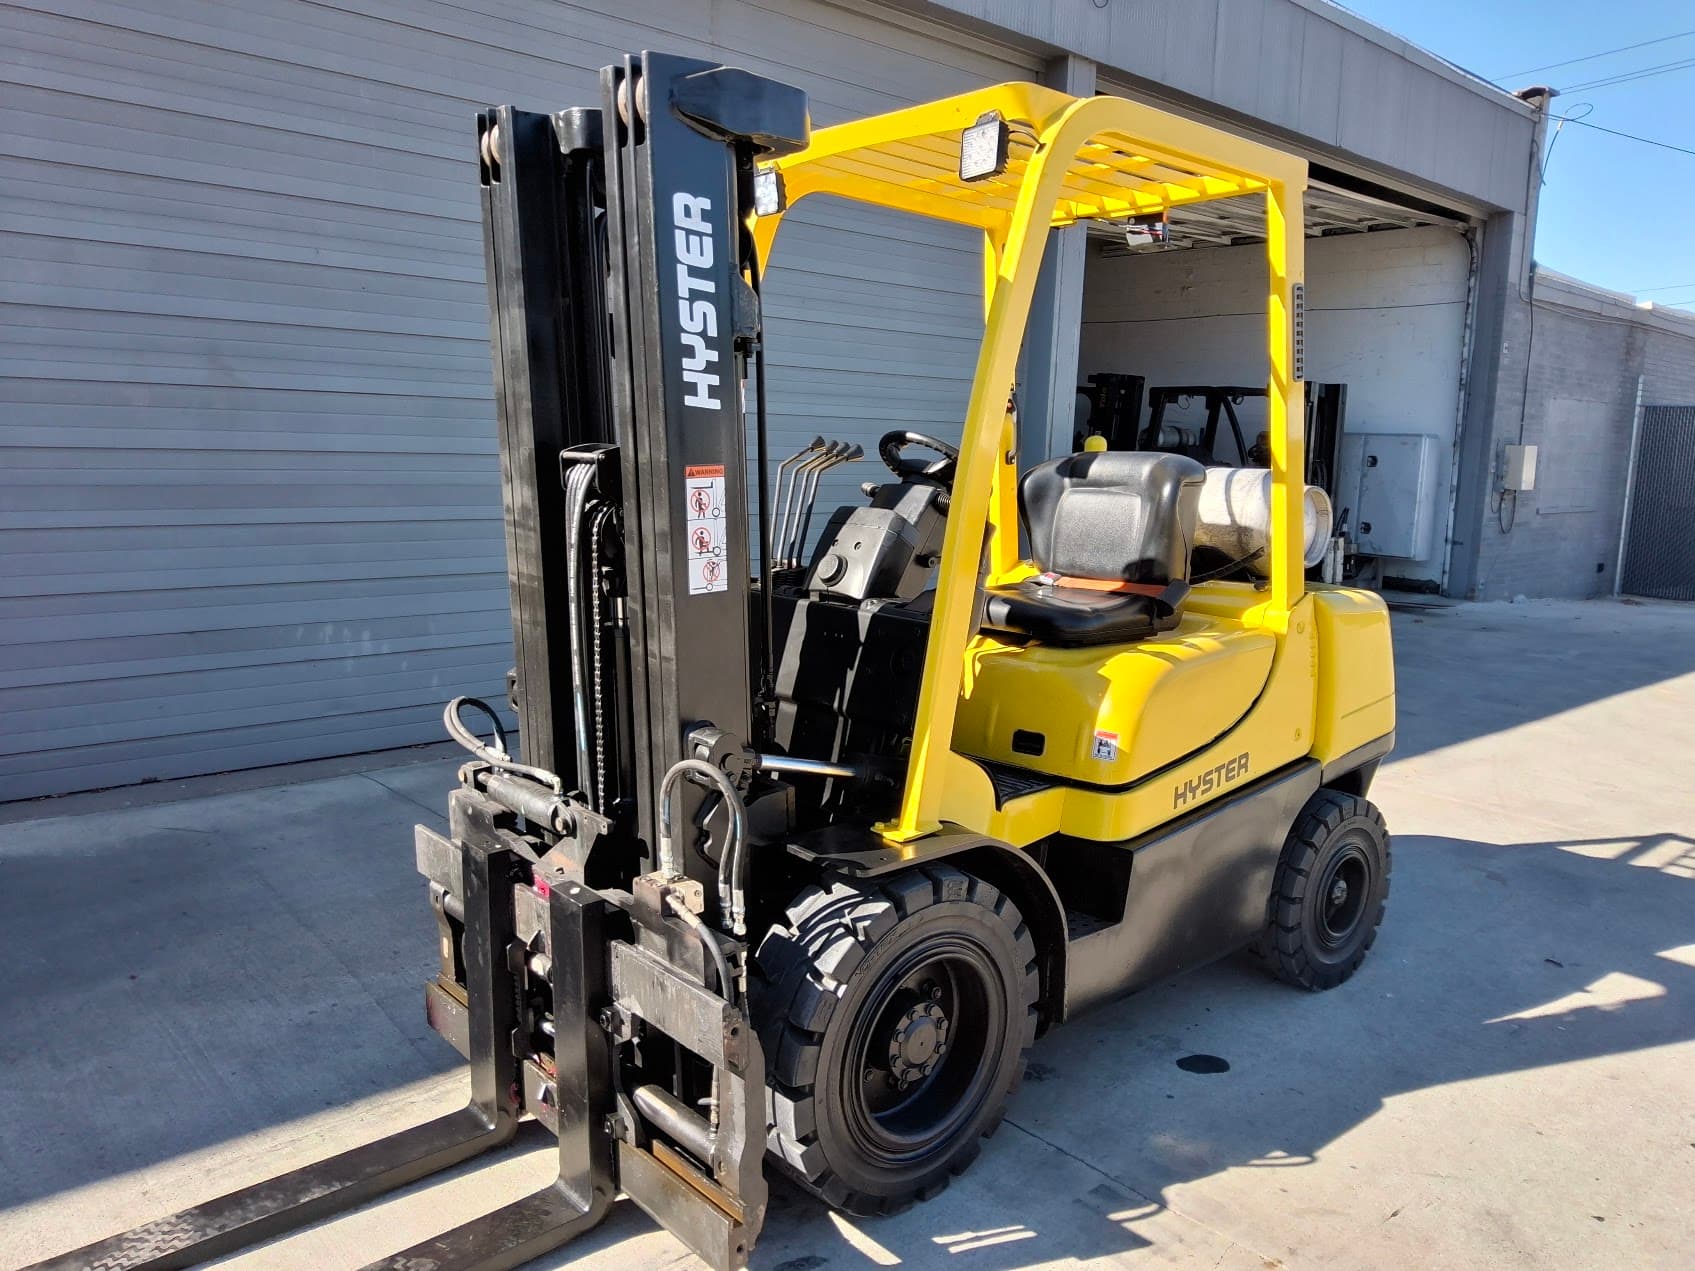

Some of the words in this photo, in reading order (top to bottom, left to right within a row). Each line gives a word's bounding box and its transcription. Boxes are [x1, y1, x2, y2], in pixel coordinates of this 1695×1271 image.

[673, 192, 721, 410] HYSTER
[694, 468, 723, 476] WARNING
[1173, 751, 1249, 810] HYSTER
